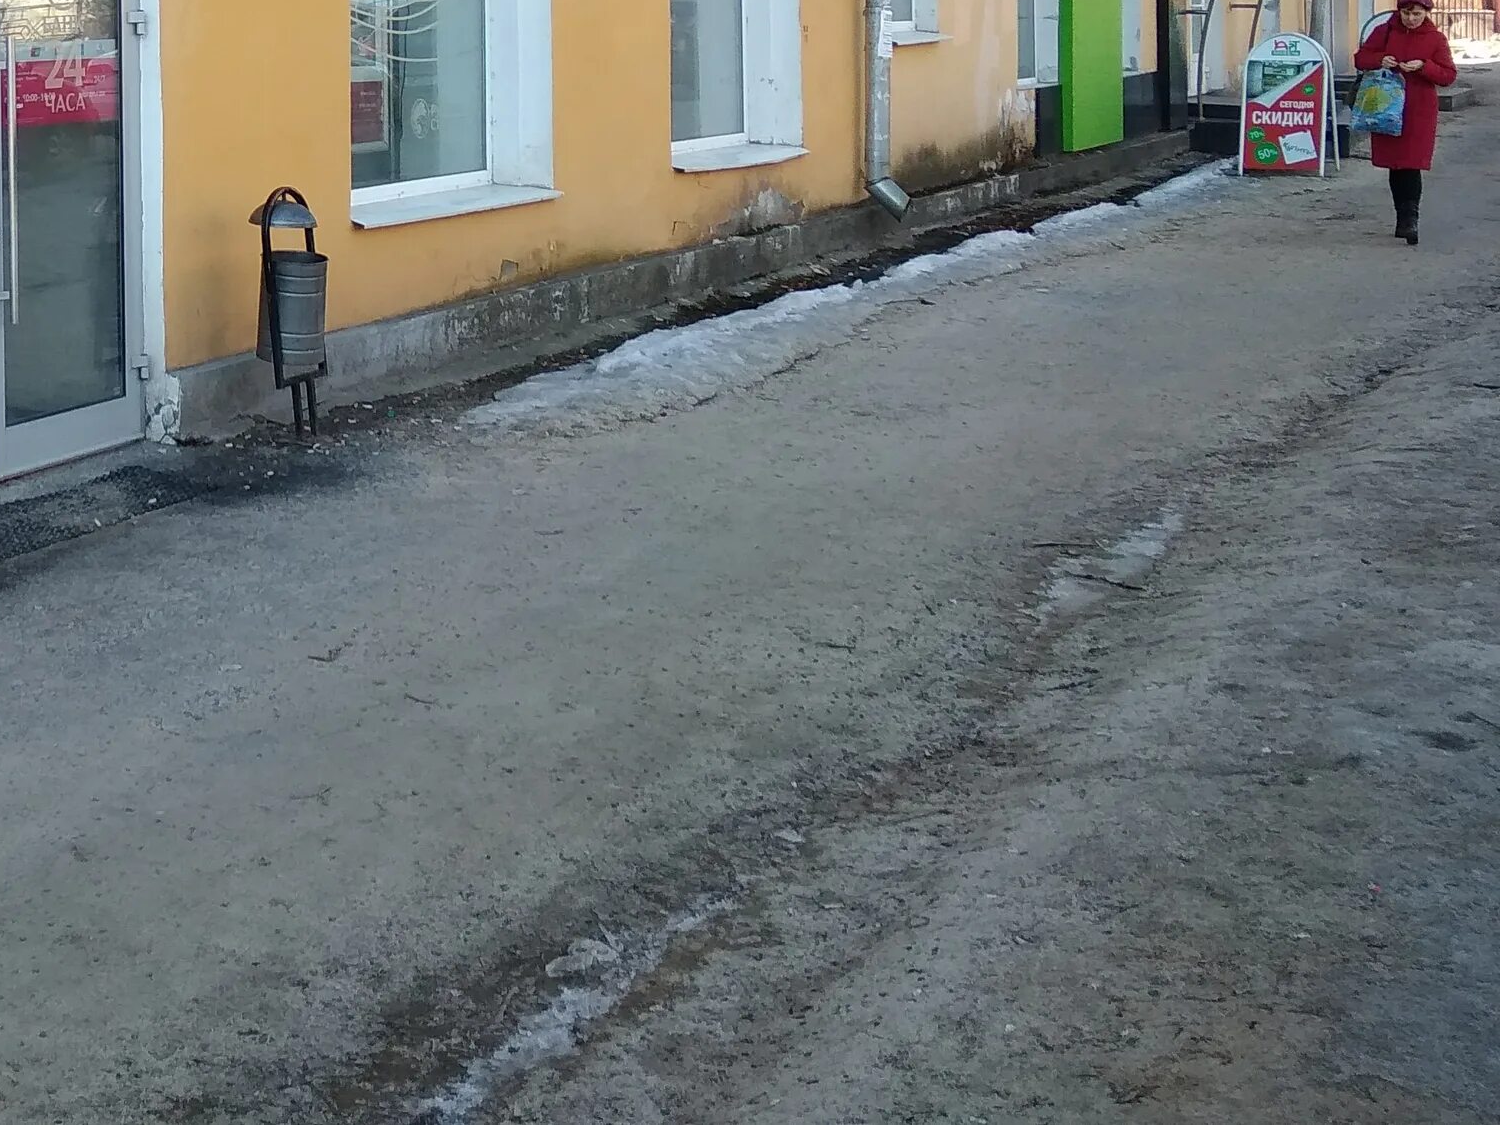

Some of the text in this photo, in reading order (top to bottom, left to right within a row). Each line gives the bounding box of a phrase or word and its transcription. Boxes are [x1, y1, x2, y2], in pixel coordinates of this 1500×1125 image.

[44, 38, 86, 90] 24
[44, 92, 86, 114] ЧАСА
[1280, 100, 1314, 109] СЕГОДНЯ
[1252, 110, 1314, 127] СКИДКИ
